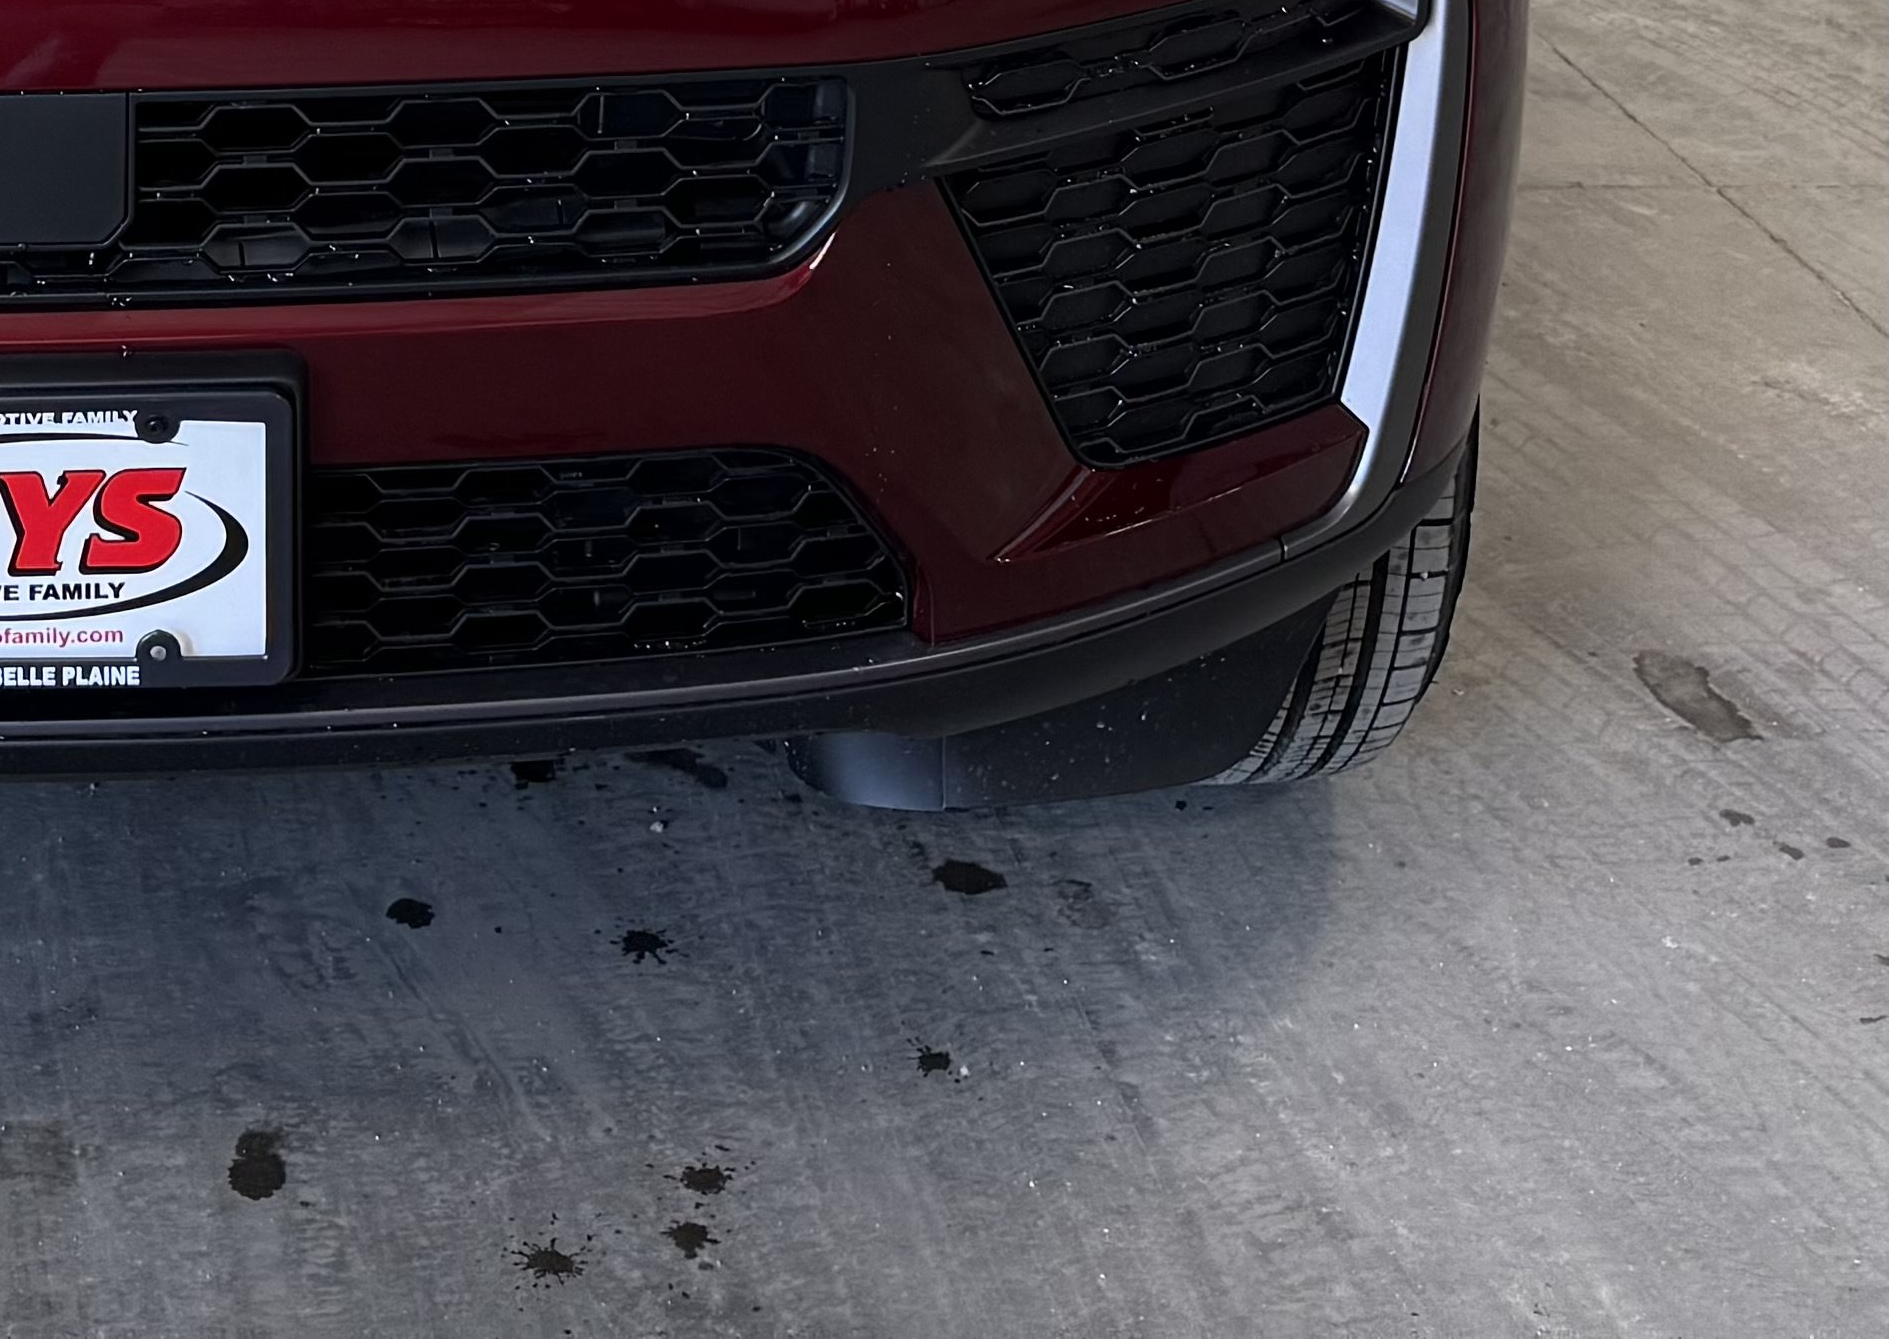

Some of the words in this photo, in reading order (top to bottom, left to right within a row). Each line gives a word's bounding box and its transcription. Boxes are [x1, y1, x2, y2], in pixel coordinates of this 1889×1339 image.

[62, 409, 138, 426] FAMILY
[29, 582, 126, 600] FAMILY
[62, 666, 141, 686] PLAINE
